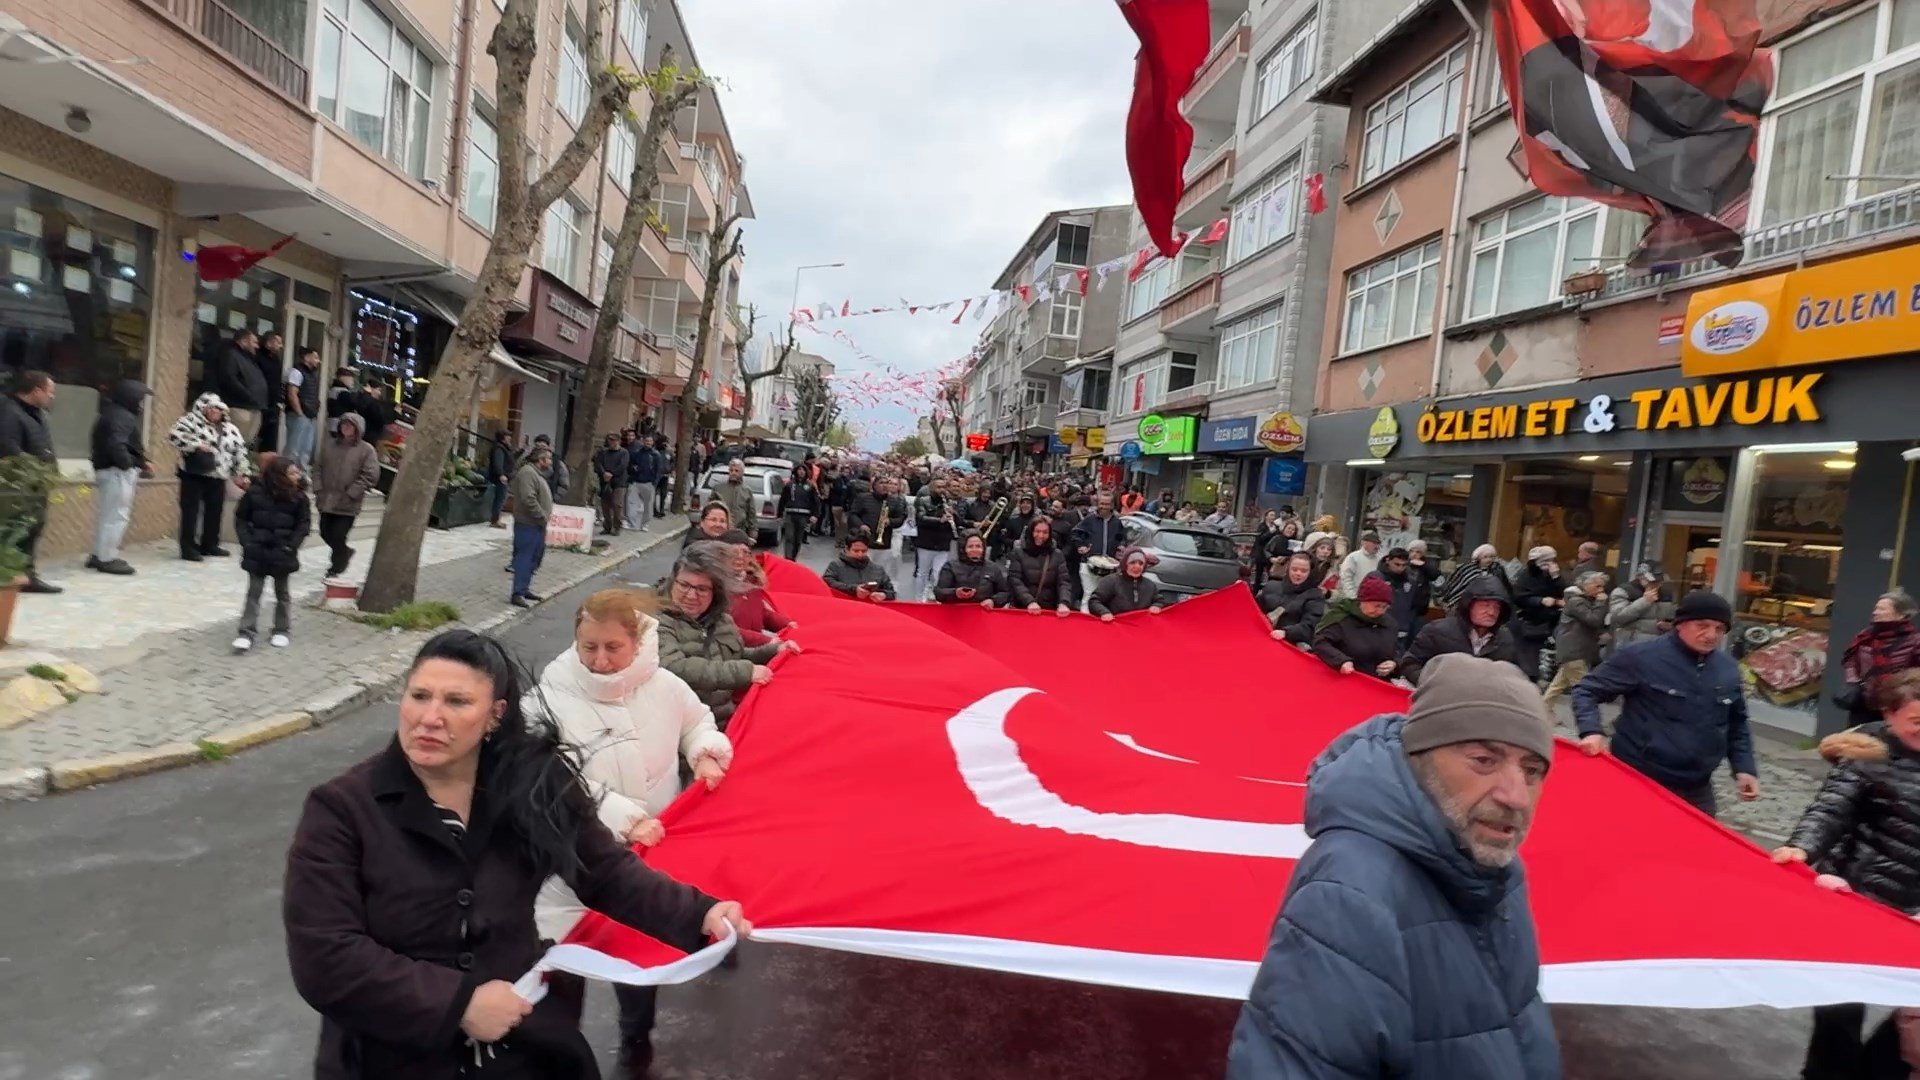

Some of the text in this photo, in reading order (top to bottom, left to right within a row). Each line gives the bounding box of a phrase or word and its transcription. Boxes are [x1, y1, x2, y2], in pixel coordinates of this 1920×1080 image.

[1796, 289, 1896, 331] ÖZLEM
[1416, 372, 1824, 443] ÖZLEM ET & TAVUK
